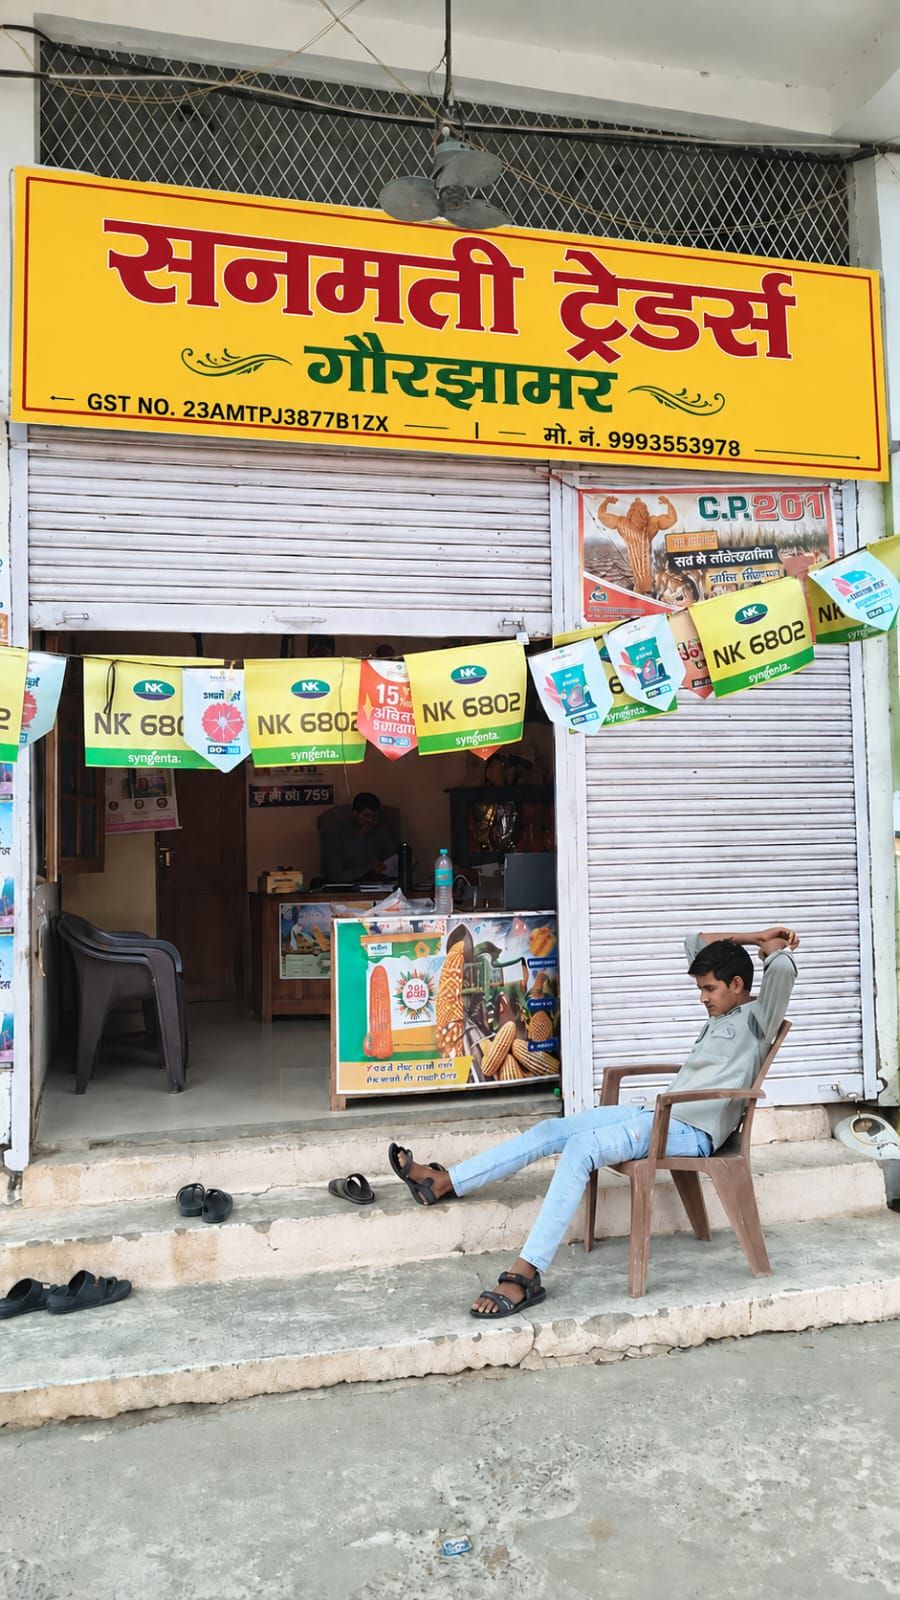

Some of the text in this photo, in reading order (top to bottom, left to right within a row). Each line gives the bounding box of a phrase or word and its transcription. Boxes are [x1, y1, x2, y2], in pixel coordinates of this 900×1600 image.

[103, 218, 797, 364] सनमती ट्रेडर्स
[304, 332, 618, 413] गौरझामर
[87, 393, 389, 432] GST NO. 23AMTPJ3877B1ZX
[543, 423, 741, 456] मो. नं. 9993553978
[743, 606, 759, 618] NK
[713, 641, 746, 669] NK
[750, 620, 806, 655] 6802
[302, 681, 320, 691] NK
[460, 667, 477, 677] NK
[145, 682, 163, 693] NK
[422, 692, 521, 723] NK 6802
[94, 712, 184, 737] NK 68
[257, 713, 292, 735] NK
